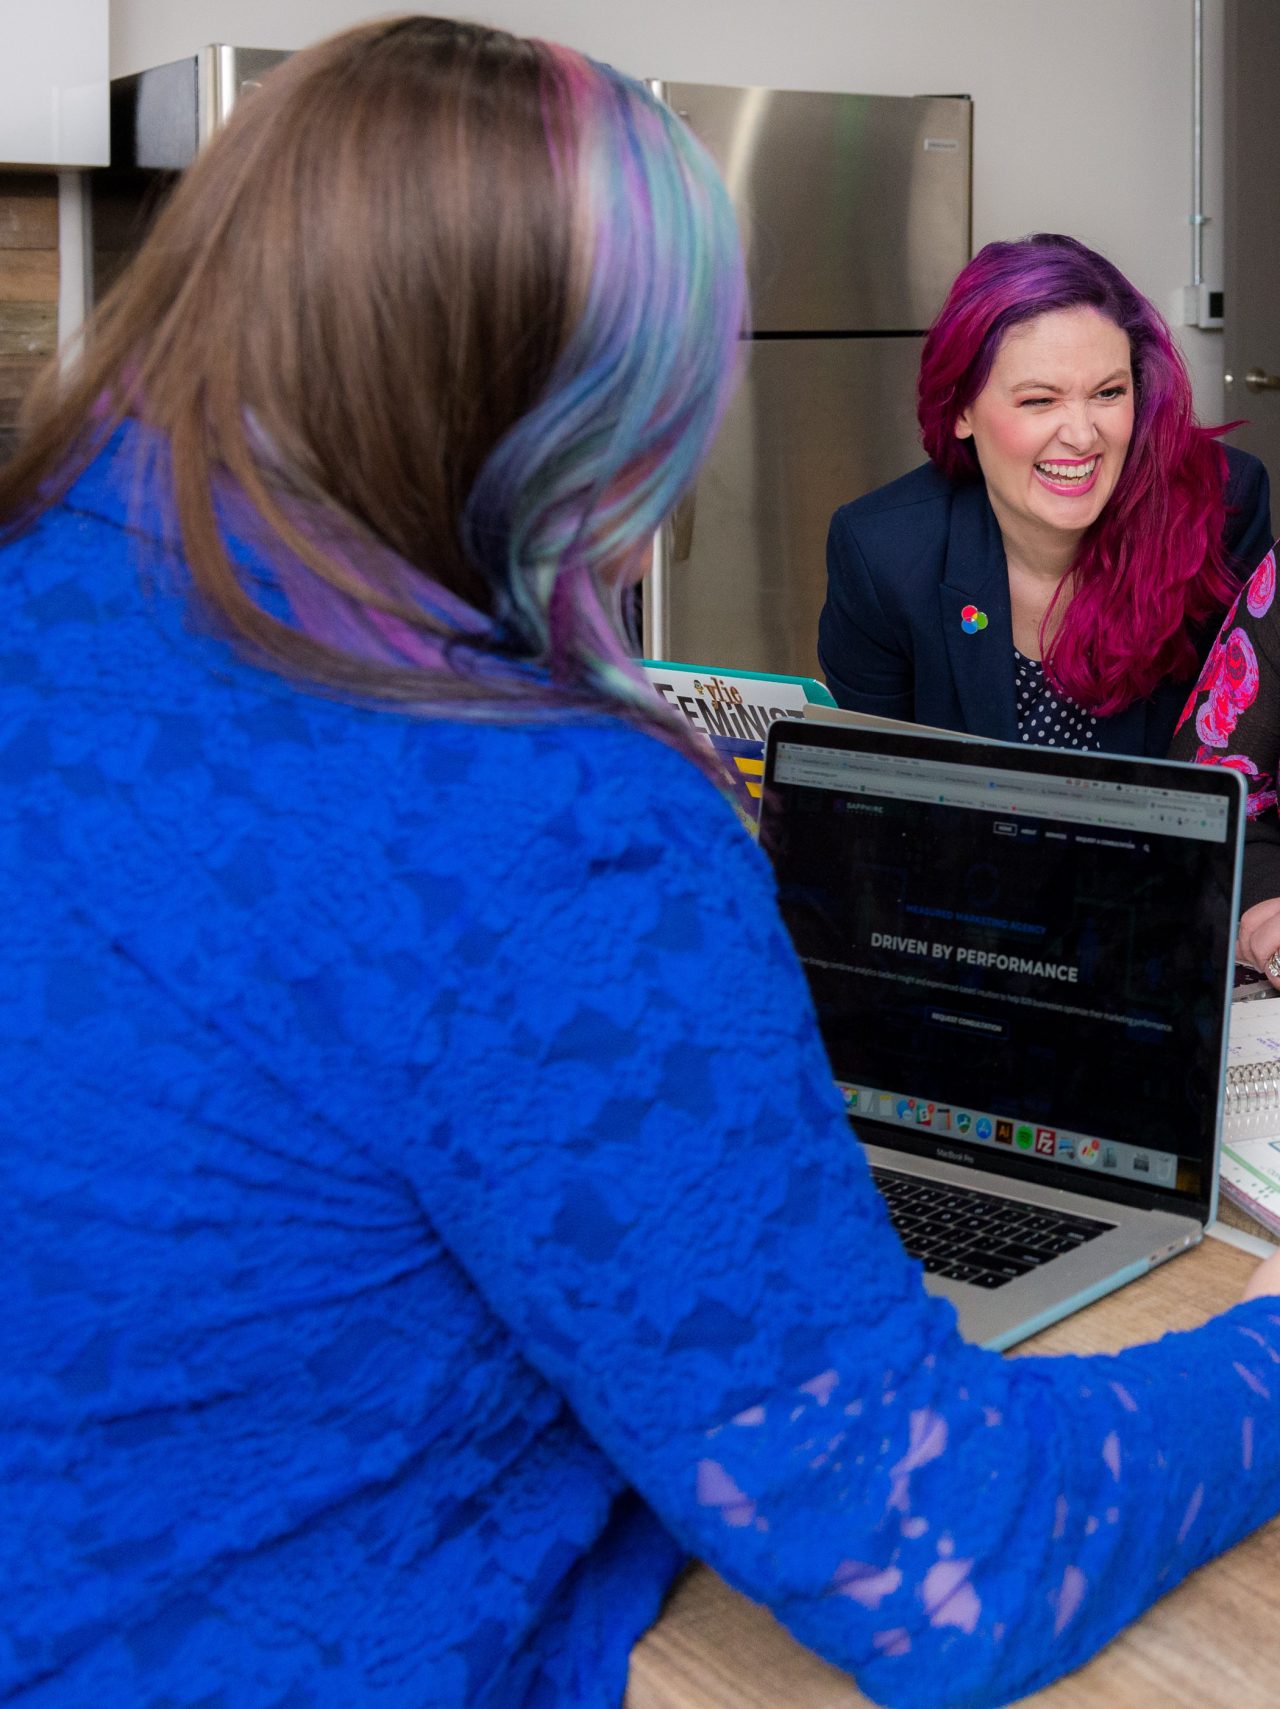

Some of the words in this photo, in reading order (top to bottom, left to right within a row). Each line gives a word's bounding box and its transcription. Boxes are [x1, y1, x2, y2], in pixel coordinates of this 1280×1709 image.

[871, 932, 928, 956] DRIVEN
[931, 943, 954, 960] BY
[956, 947, 1079, 983] PERFORMANCE
